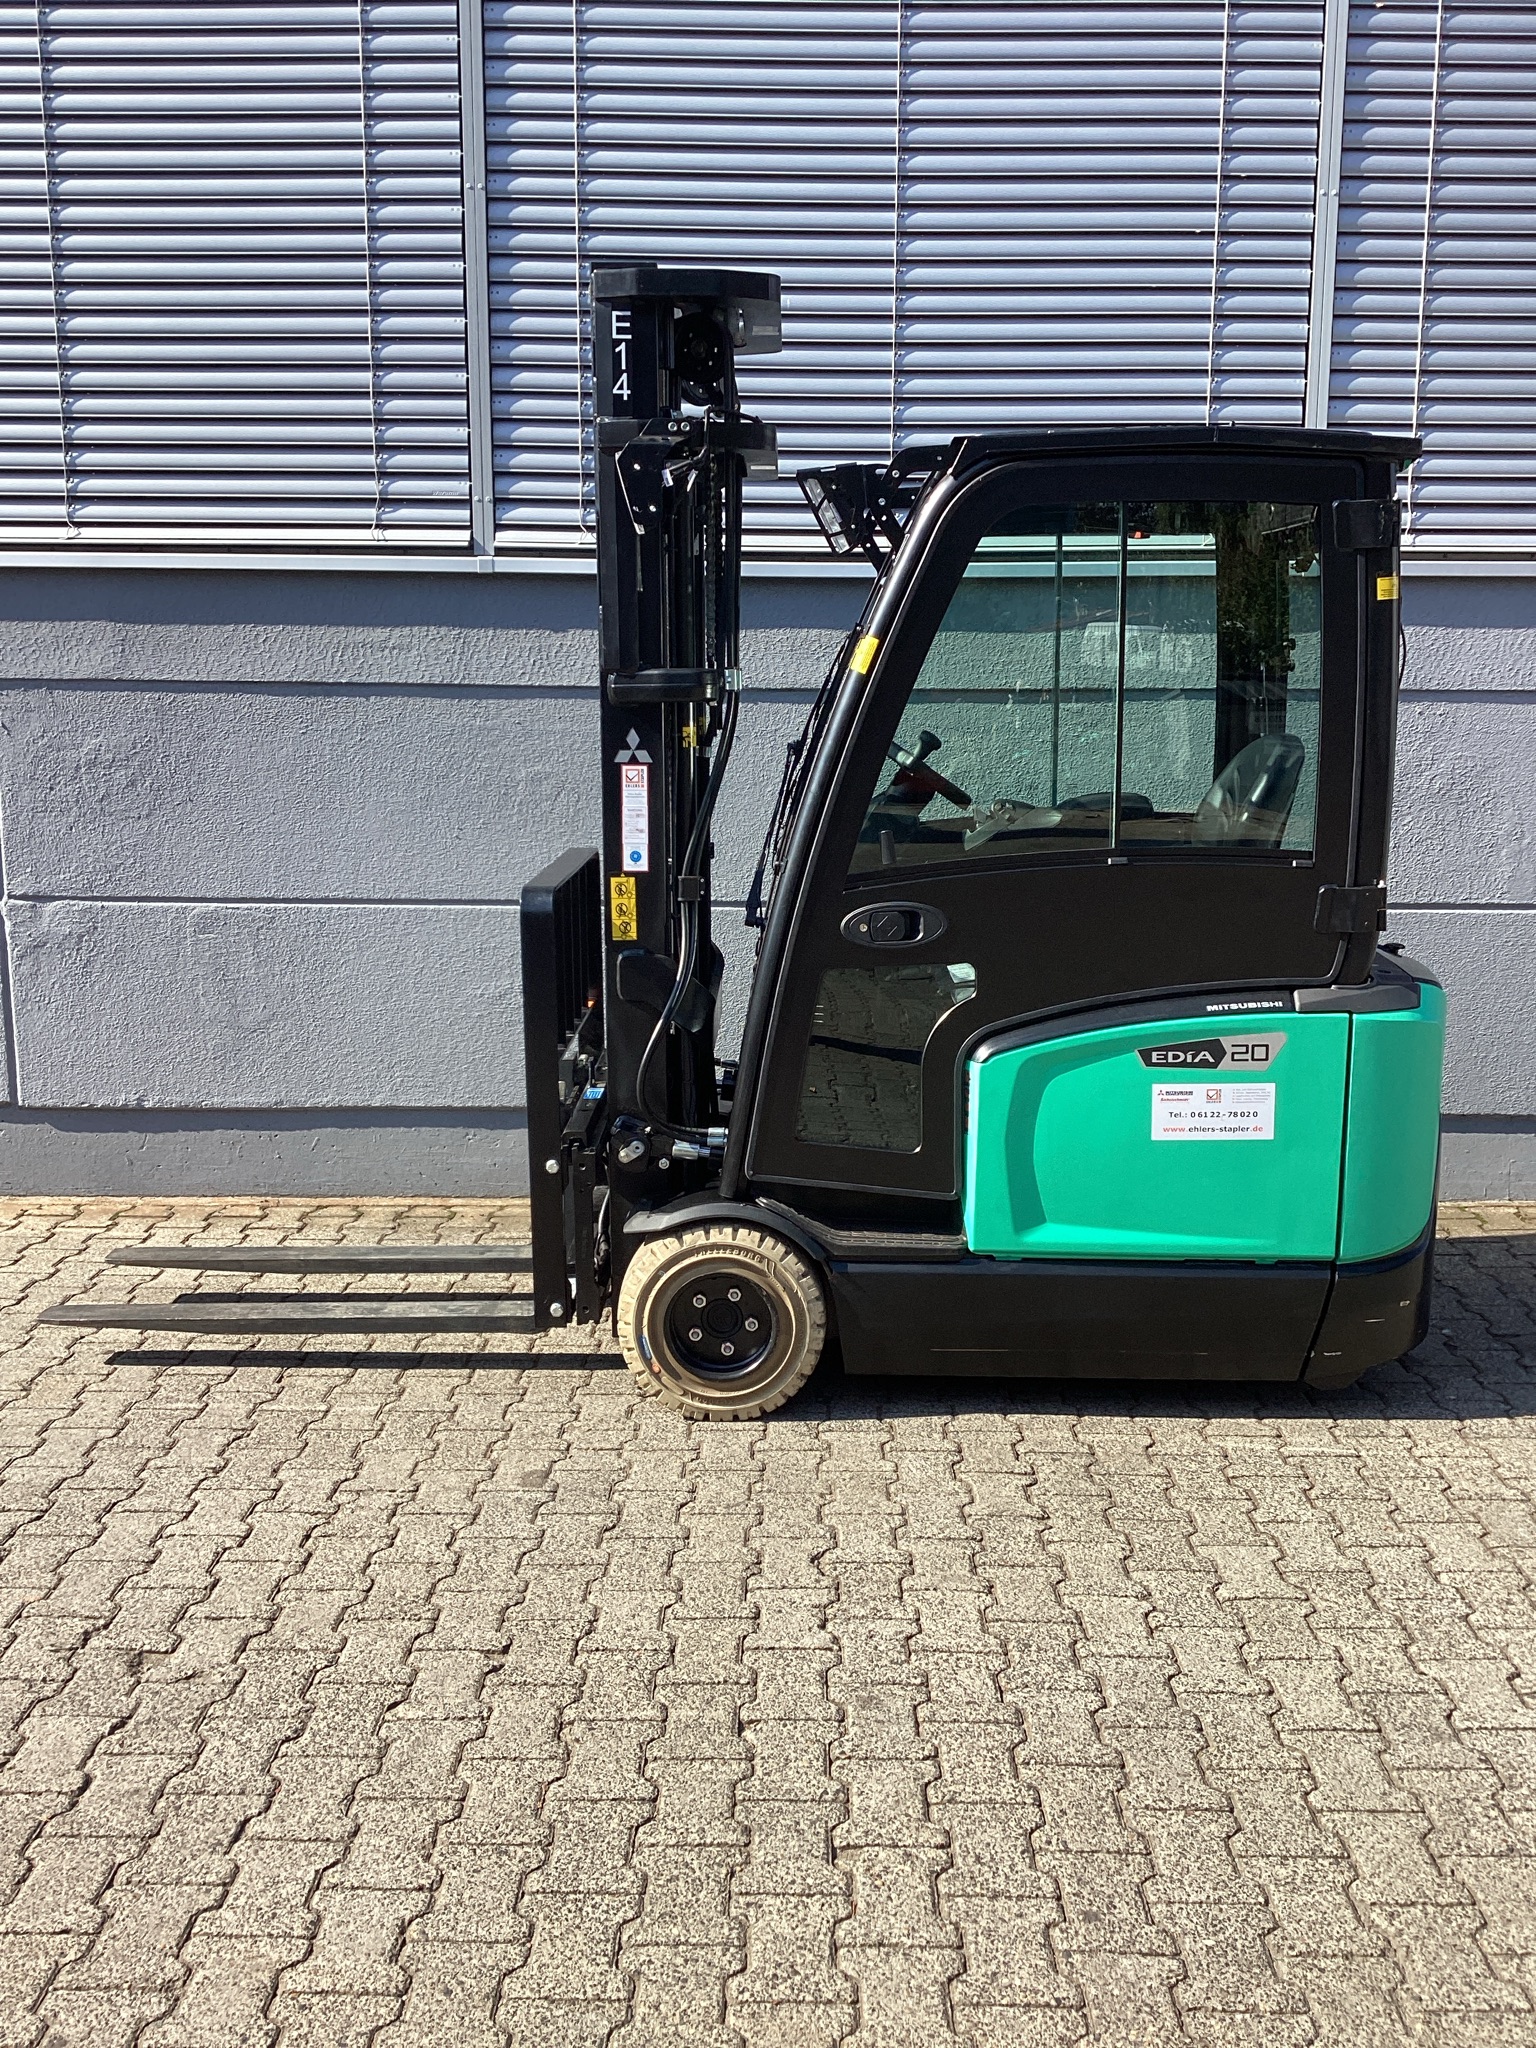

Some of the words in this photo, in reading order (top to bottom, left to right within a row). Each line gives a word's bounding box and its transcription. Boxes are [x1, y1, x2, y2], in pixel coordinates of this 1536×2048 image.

[611, 310, 632, 401] E14
[1206, 1001, 1283, 1012] MITSUBISHI
[1231, 1044, 1270, 1062] 20
[1168, 1111, 1188, 1119] Tel.:
[1162, 1125, 1264, 1134] www.ehlers-stapler.de
